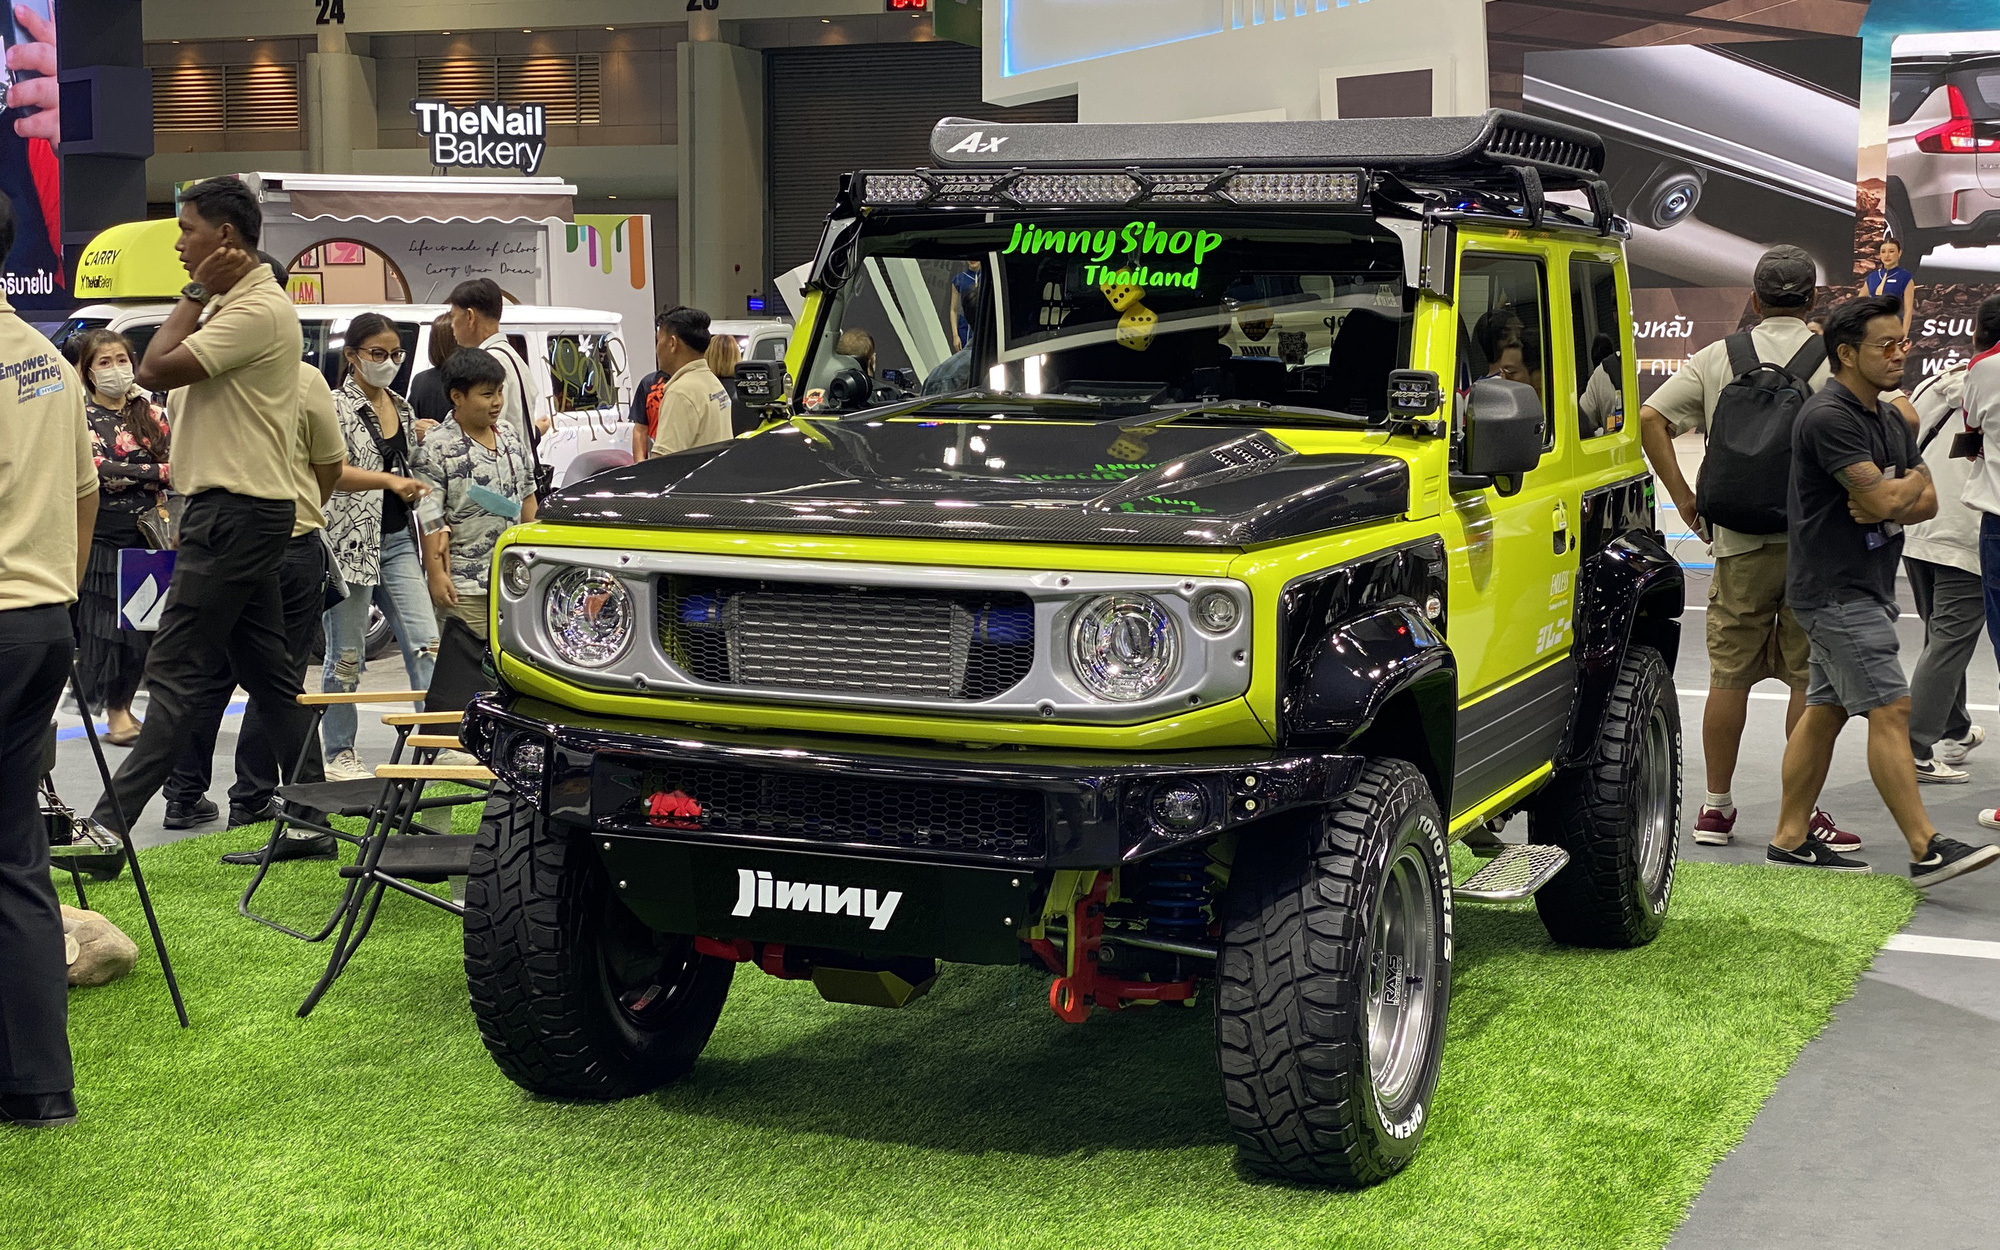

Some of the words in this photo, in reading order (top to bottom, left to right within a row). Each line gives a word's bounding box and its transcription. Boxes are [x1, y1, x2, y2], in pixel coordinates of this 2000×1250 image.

[315, 0, 345, 24] 24
[435, 133, 542, 173] Bakery
[84, 249, 122, 266] CARRY
[409, 240, 432, 256] Life
[436, 244, 448, 252] is
[451, 240, 481, 251] made
[486, 241, 499, 257] of
[503, 242, 540, 254] Colors
[425, 263, 460, 277] Carry
[500, 262, 534, 274] Dream
[298, 281, 315, 302] AM
[0, 353, 48, 381] Empower
[18, 364, 61, 396] Journey
[1663, 803, 1681, 903] COUNTRY
[731, 869, 903, 931] Jimny
[1416, 815, 1444, 857] TOYO
[1438, 857, 1452, 963] TIRES
[1383, 954, 1398, 1005] RAYS
[1395, 1103, 1423, 1139] OPEN
